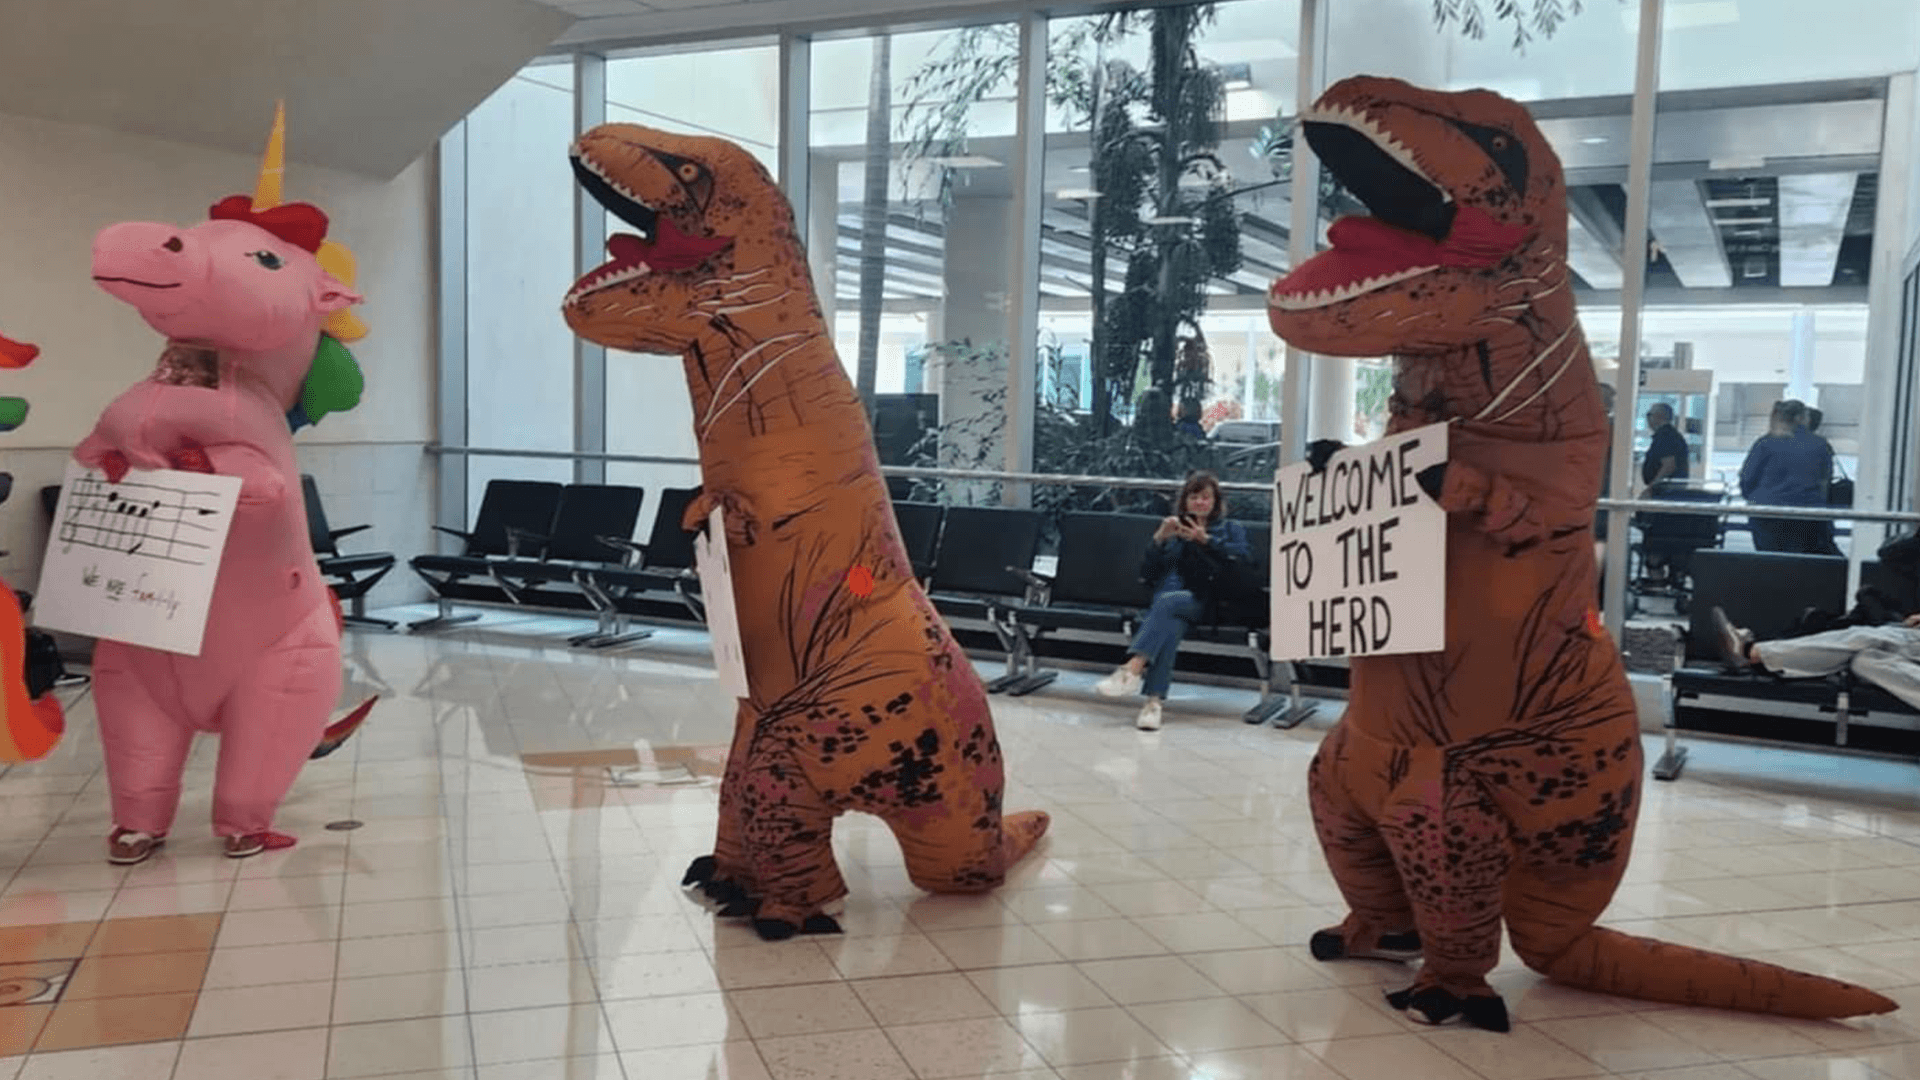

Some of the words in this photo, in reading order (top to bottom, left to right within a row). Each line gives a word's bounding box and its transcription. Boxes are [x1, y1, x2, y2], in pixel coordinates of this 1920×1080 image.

[1276, 438, 1420, 534] WELCOME
[1280, 539, 1313, 595] TO
[1336, 516, 1399, 588] THE
[1309, 595, 1391, 656] HERD
